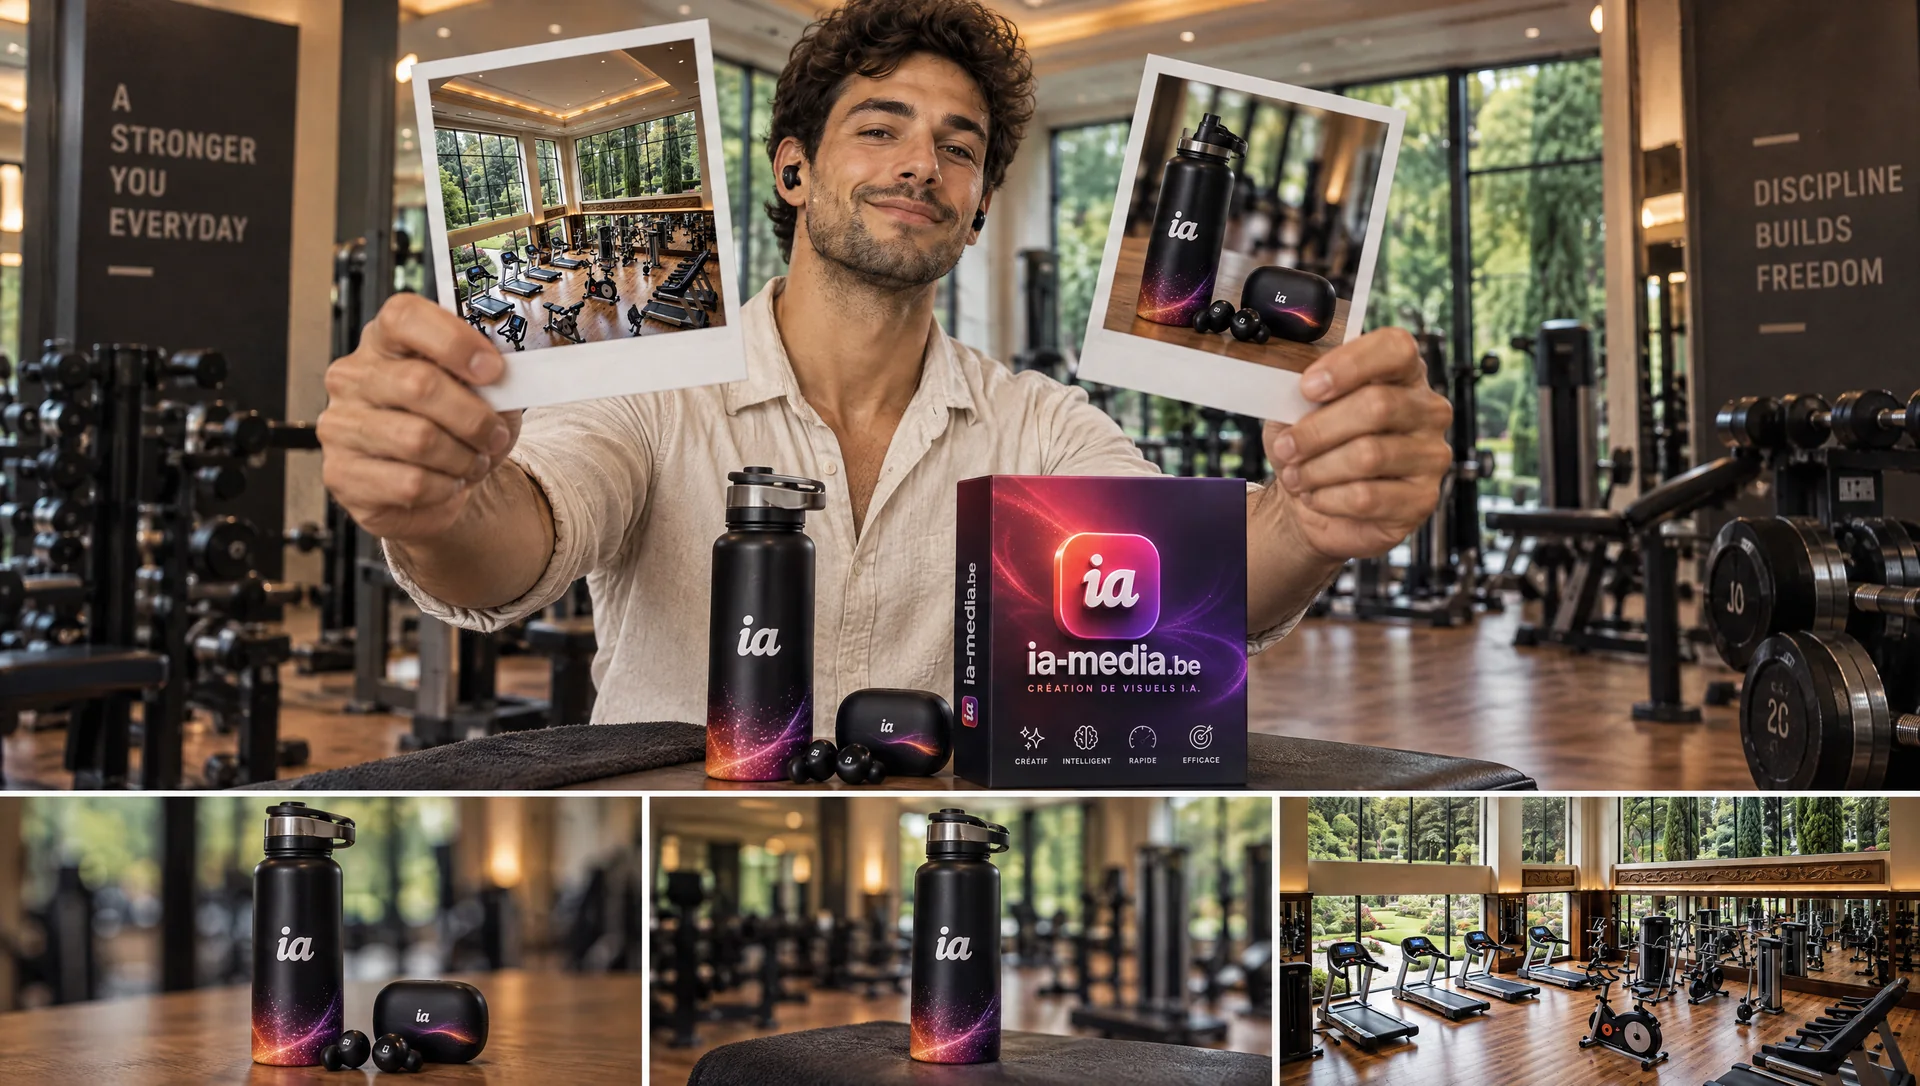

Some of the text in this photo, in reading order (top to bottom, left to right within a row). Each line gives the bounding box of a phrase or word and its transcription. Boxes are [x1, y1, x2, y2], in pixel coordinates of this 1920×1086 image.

[112, 83, 132, 112] A
[111, 124, 257, 165] STRONGER
[109, 165, 167, 197] YOU
[1754, 164, 1904, 207] DISCIPLINE
[108, 207, 249, 243] EVERYDAY
[1168, 210, 1199, 241] ia
[1755, 215, 1853, 249] BUILDS
[1757, 256, 1884, 292] FREEDOM
[1274, 291, 1287, 304] ia
[1082, 552, 1140, 609] ia
[736, 614, 782, 657] ia
[963, 562, 977, 685] ia-media.be
[1027, 640, 1201, 676] ia-media.be
[1027, 682, 1201, 693] CRÉATION DE VISUELS I.A.
[880, 718, 894, 733] ia
[963, 702, 975, 722] ia
[1014, 756, 1049, 765] CRÉATIF
[1062, 757, 1112, 765] INTELLIGENT
[1182, 756, 1220, 764] EFFICACE
[276, 926, 315, 962] ia
[935, 926, 973, 961] ia
[415, 1008, 430, 1023] ia
